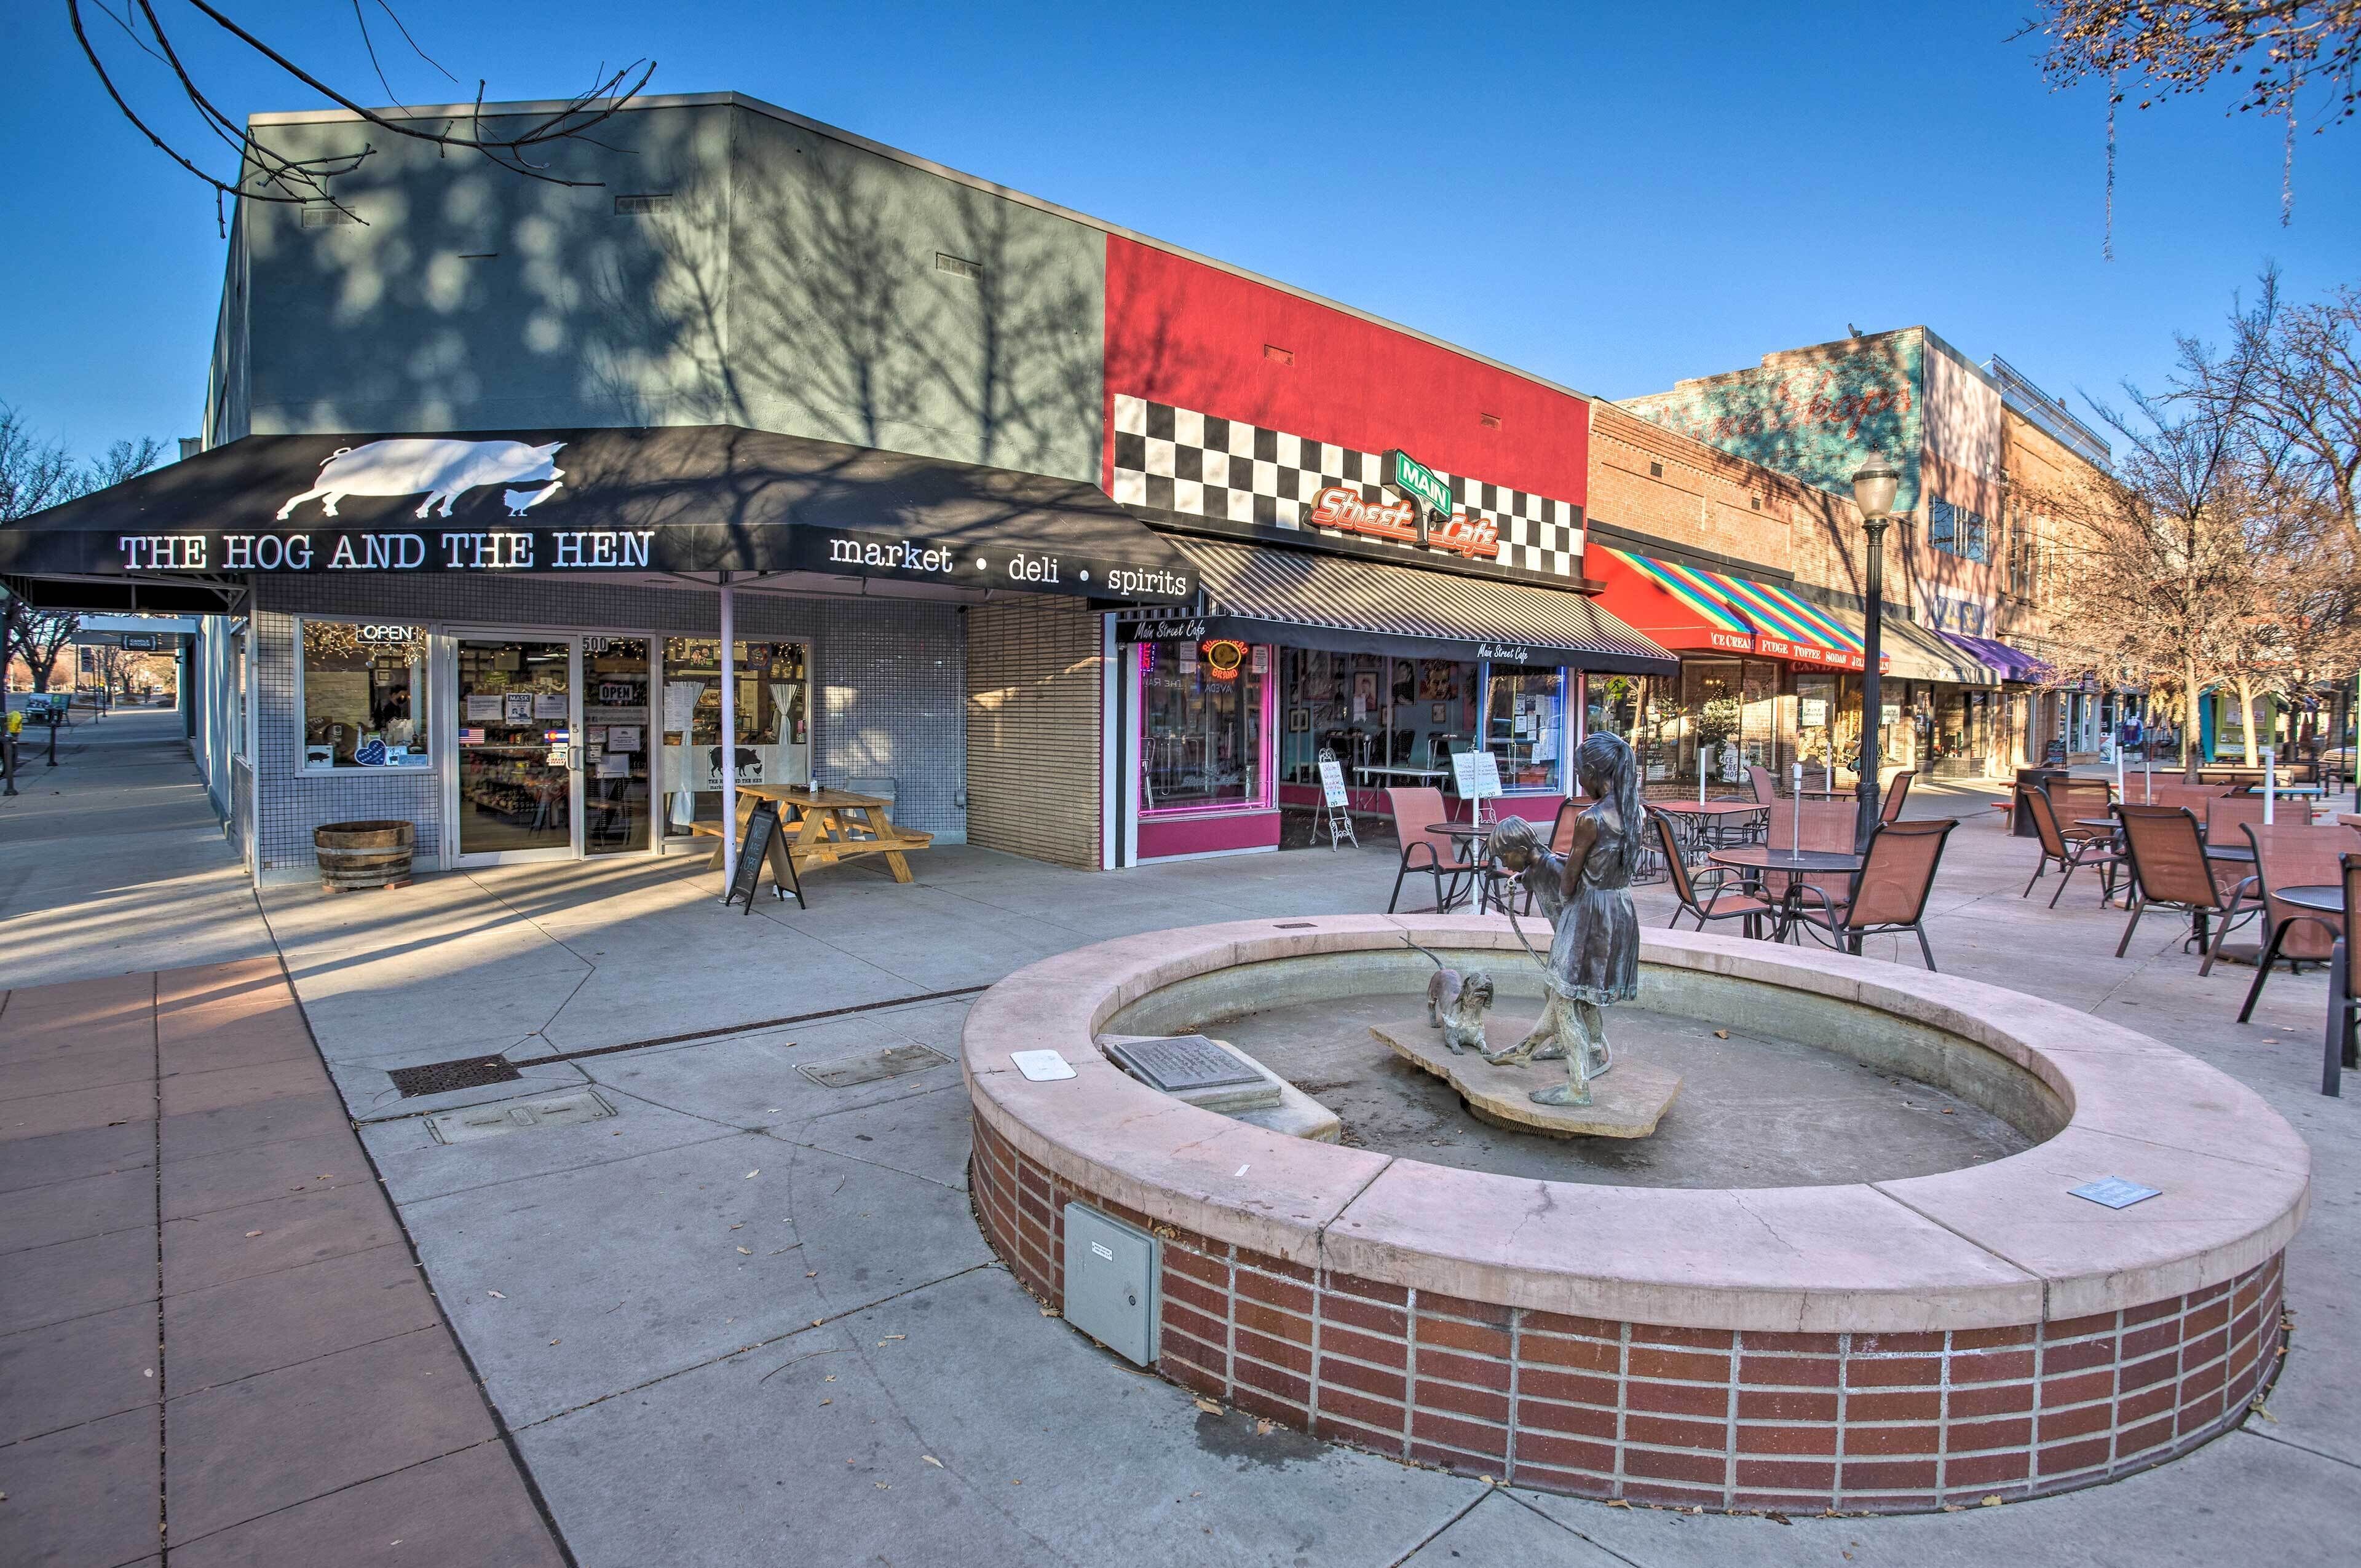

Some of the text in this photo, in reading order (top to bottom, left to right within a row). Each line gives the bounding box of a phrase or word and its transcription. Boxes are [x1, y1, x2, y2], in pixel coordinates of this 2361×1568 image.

[1402, 461, 1447, 506] MAIN
[1312, 488, 1499, 557] Street Cafe
[119, 530, 655, 569] THE HOG AND THE HEN
[829, 538, 953, 573] market
[1008, 554, 1059, 583] deli
[1108, 569, 1187, 596] spirits
[363, 625, 412, 640] OPEN
[582, 637, 607, 651] 500
[1134, 620, 1205, 641] Main Street Cafe
[1477, 644, 1528, 664] Main Street Cafe
[1711, 632, 1725, 645] ICE
[1726, 635, 1754, 650] CREAM
[1762, 639, 1788, 654] FUDGE
[1793, 645, 1821, 660] TOFFEE
[1825, 651, 1847, 664] SODAS
[1211, 668, 1238, 679] BRAND
[603, 687, 630, 698] OPEN
